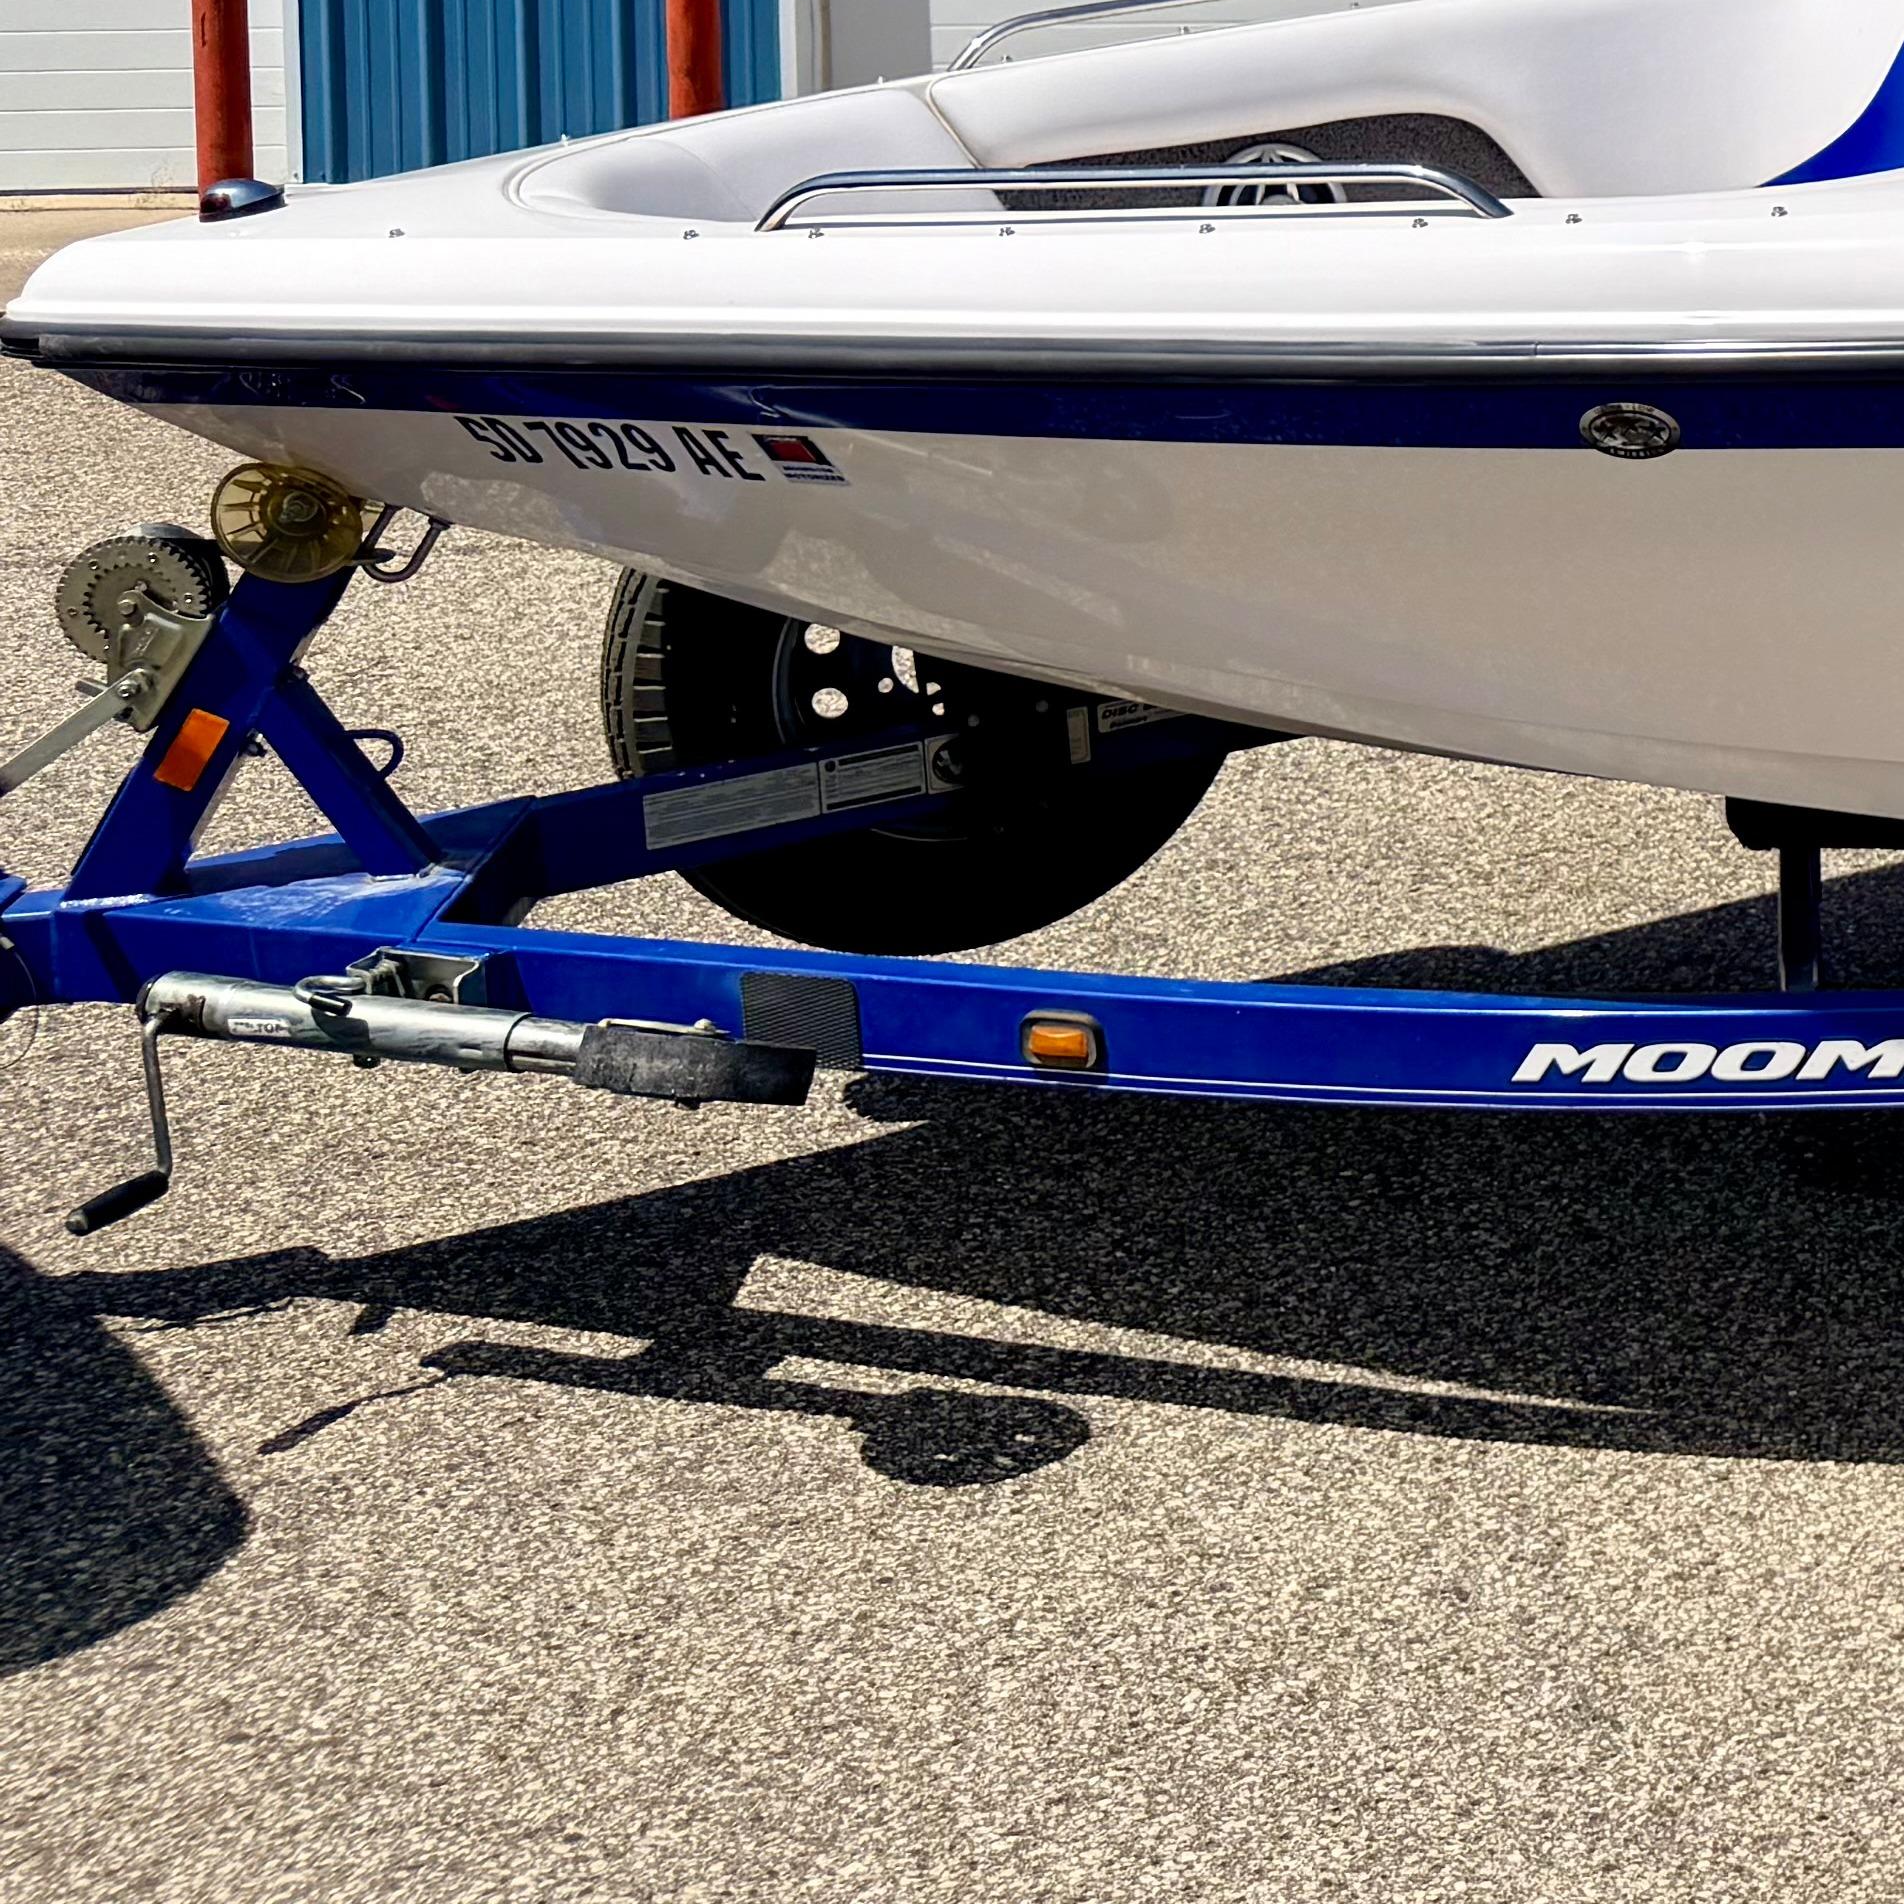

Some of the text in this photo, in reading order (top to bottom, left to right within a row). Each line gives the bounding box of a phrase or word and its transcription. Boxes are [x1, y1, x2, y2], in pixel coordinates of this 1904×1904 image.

[453, 415, 767, 482] SD 7929 AE
